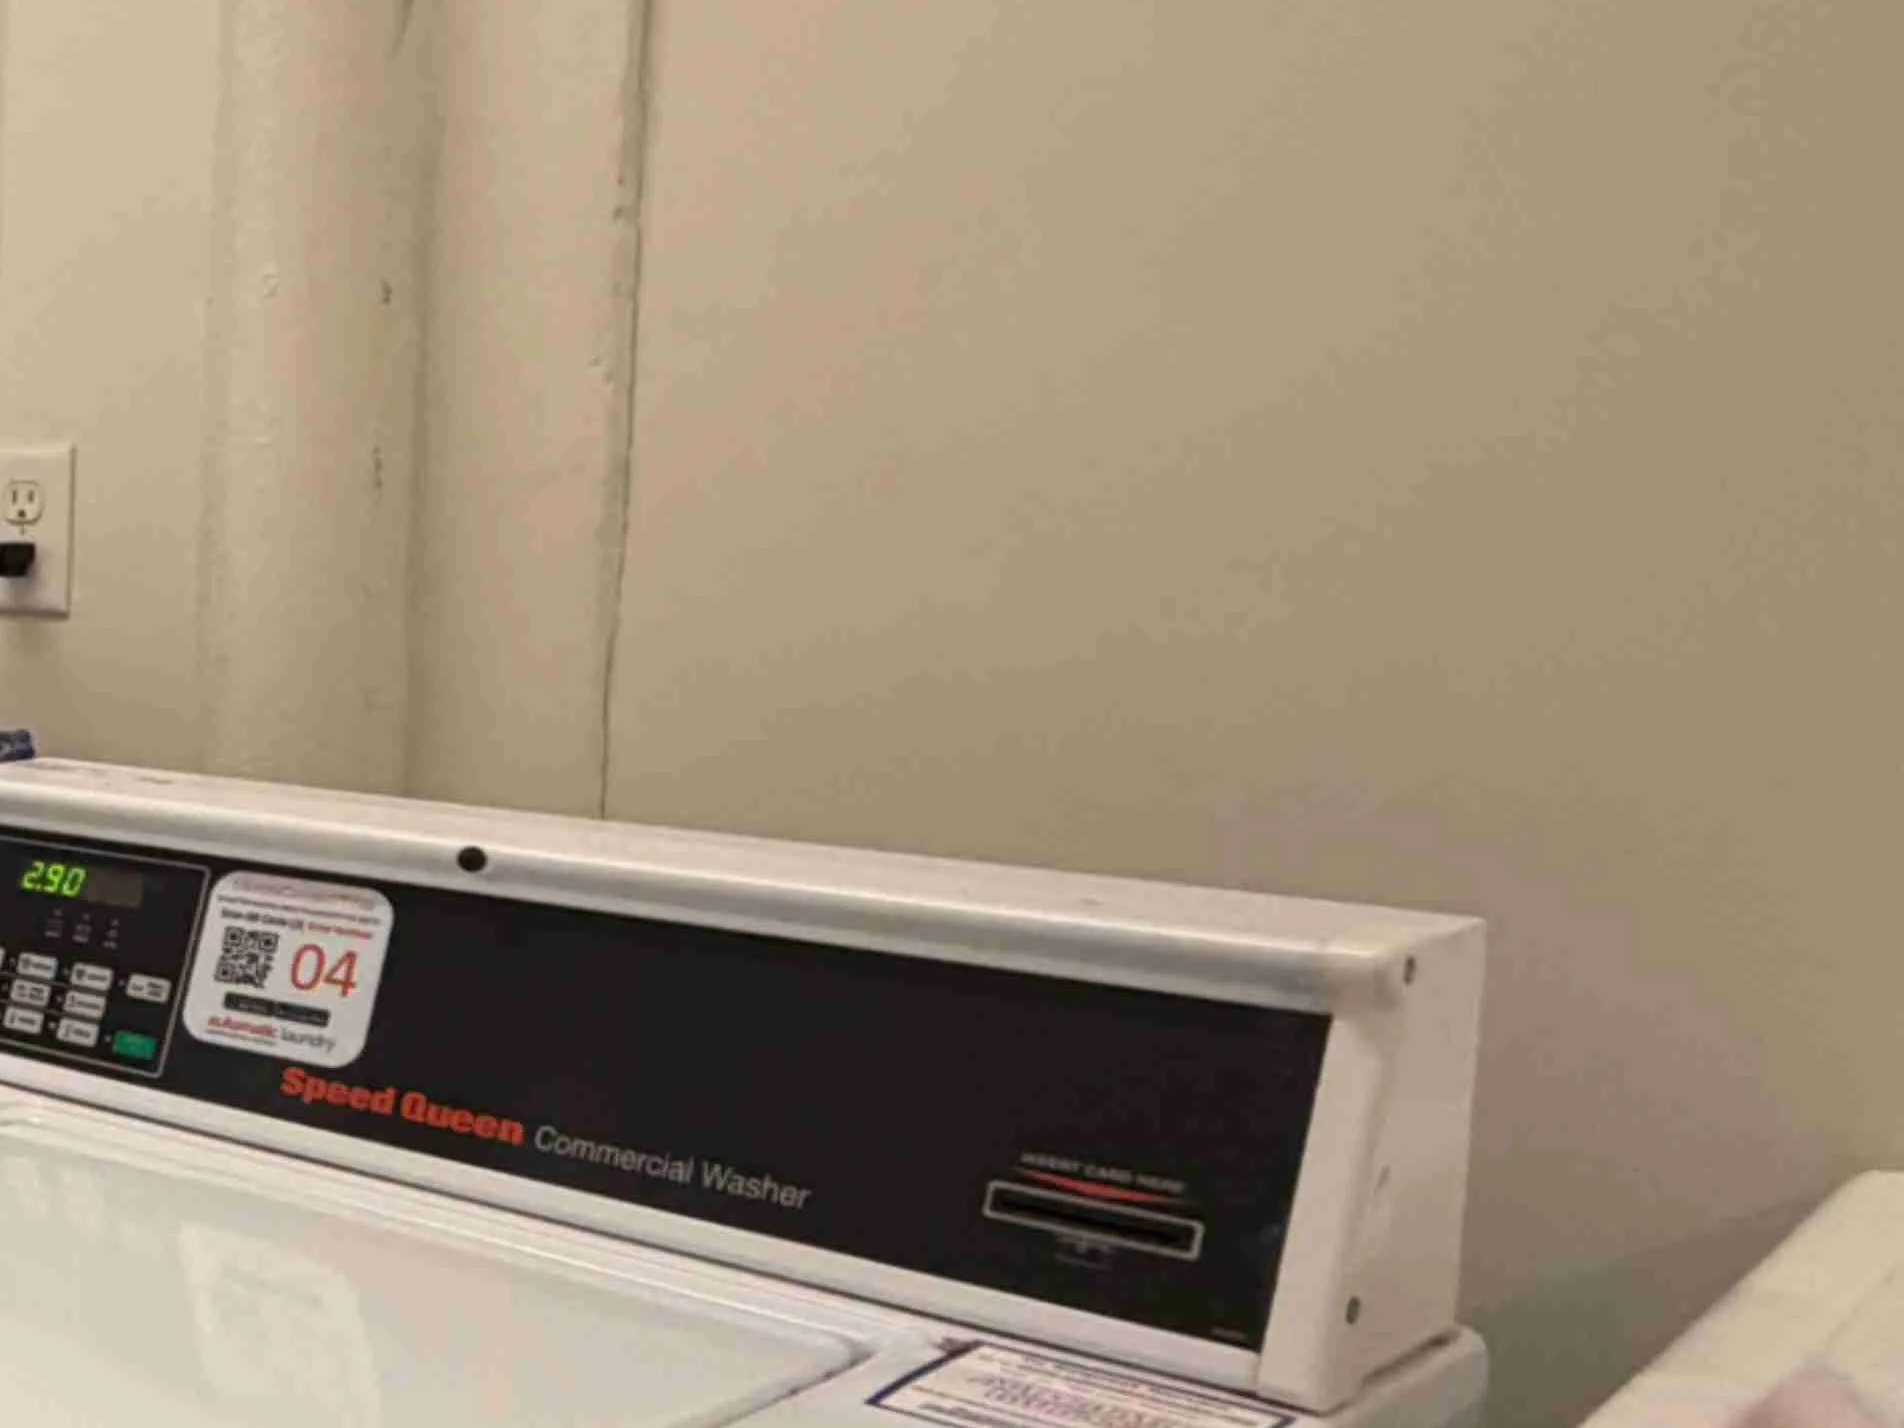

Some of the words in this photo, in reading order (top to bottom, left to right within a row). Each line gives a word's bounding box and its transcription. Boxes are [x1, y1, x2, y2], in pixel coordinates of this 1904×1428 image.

[290, 943, 359, 997] 04
[207, 1016, 277, 1038] automatic
[280, 1026, 337, 1054] laundry
[280, 1066, 396, 1116] Speed
[400, 1092, 525, 1146] Queen
[534, 1125, 693, 1183] Commercial
[700, 1160, 813, 1210] Washer
